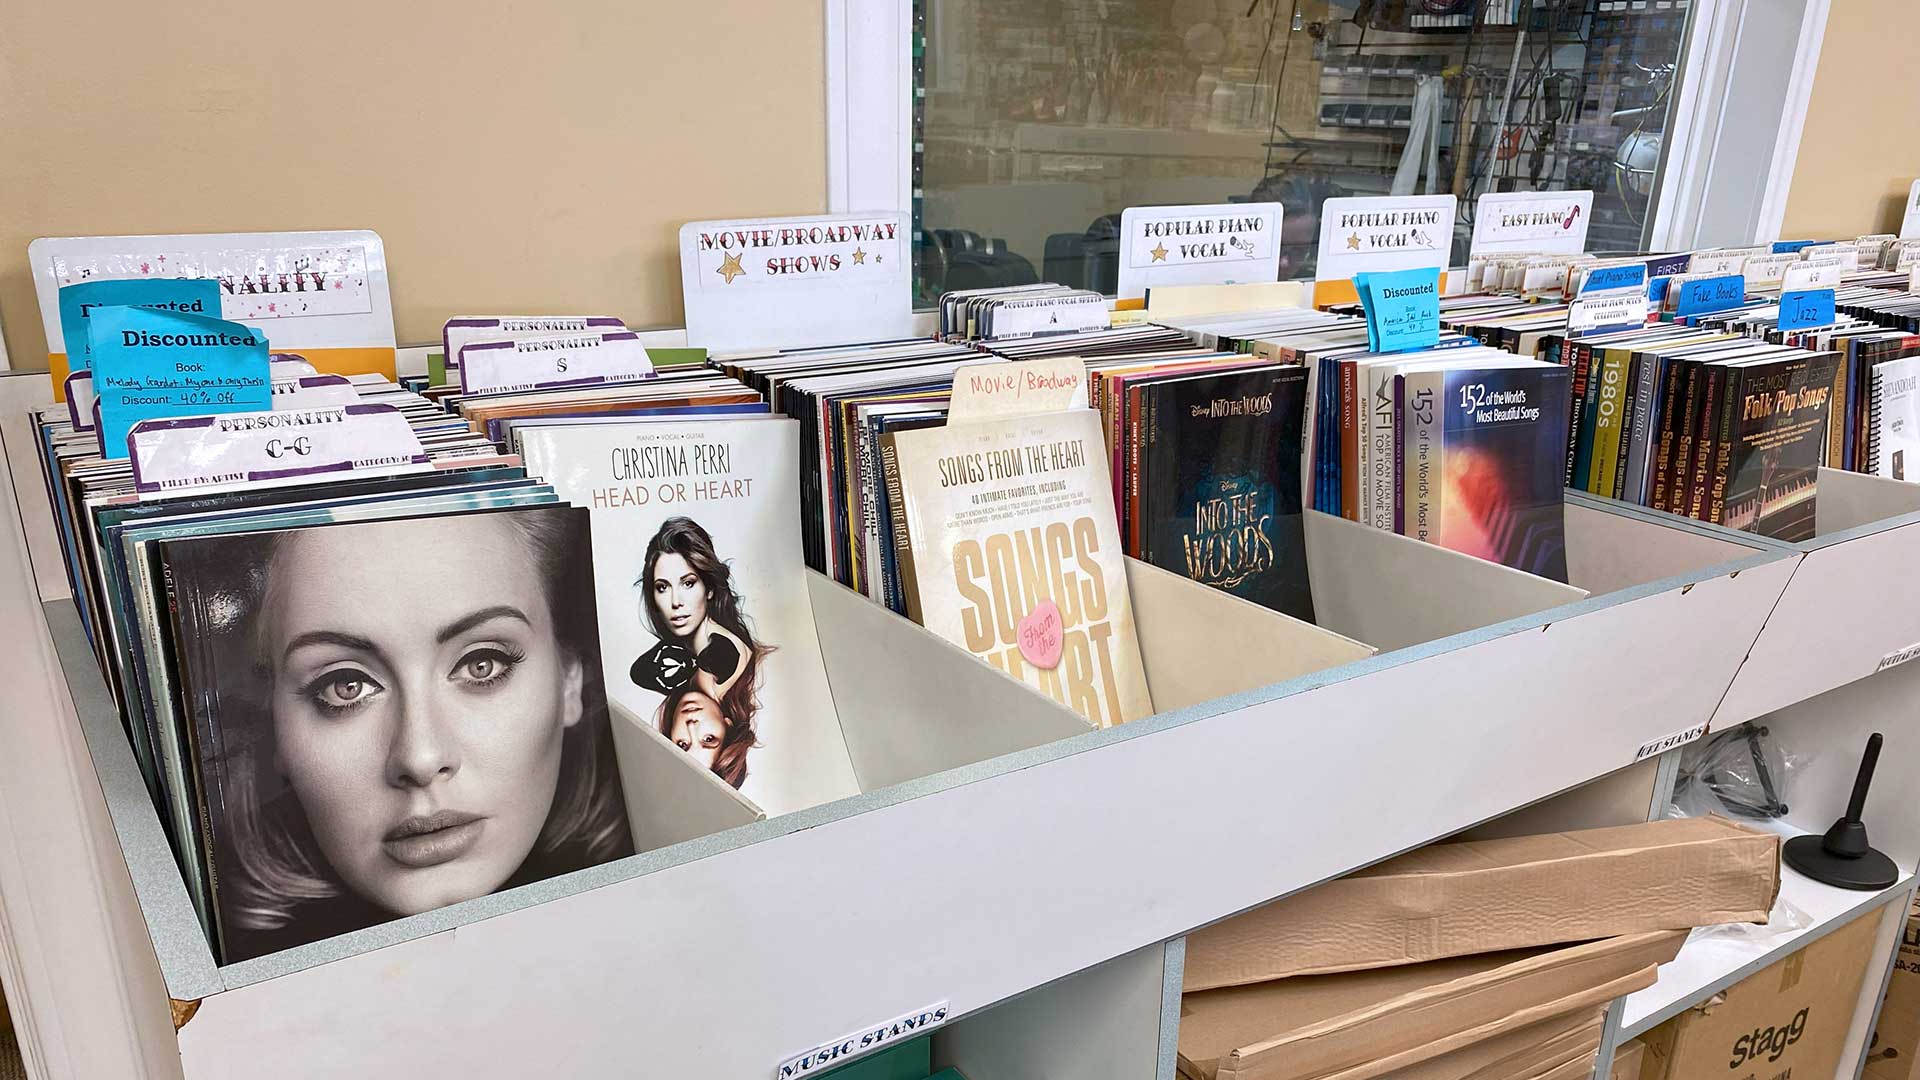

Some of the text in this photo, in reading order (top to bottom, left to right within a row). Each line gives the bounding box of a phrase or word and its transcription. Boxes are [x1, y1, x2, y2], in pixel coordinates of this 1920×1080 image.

[1143, 216, 1264, 238] POPULAR PIANO
[1341, 211, 1440, 228] POPULAR PIANO
[1502, 211, 1566, 228] EASY PIANO
[700, 223, 897, 250] MOVIE/BROADWAY
[1369, 233, 1409, 248] VOCAL
[1180, 243, 1228, 259] VOCAL
[766, 254, 842, 275] SHOWS
[1656, 262, 1683, 276] FIRST
[1382, 282, 1434, 299] Discounted
[1715, 282, 1738, 300] Books
[1049, 311, 1058, 324] A
[1791, 296, 1818, 323] Jazz
[122, 330, 257, 347] Discounted
[503, 321, 586, 332] PERSONALITY
[516, 337, 601, 353] PERSONALITY
[1570, 347, 1579, 366] TOP
[176, 363, 206, 373] Book:
[556, 357, 568, 373] S
[106, 377, 143, 391] Melody
[1344, 367, 1354, 403] america's
[1669, 378, 1677, 394] MOST
[1687, 381, 1695, 398] MOST
[1747, 366, 1834, 393] THE MOST REQUESTED
[122, 395, 172, 406] Discount:
[217, 392, 235, 403] Off
[1190, 393, 1272, 418] Disney INTO THE WOODS
[1458, 383, 1526, 414] 152 of the World's
[1599, 360, 1619, 428] 1980s
[1634, 361, 1652, 441] rest in peace
[1726, 386, 1734, 403] MOST
[1743, 386, 1829, 421] Folk/Pop Songs
[219, 410, 345, 432] PERSONALITY
[1375, 392, 1392, 430] AFI
[1476, 406, 1540, 423] Most Beautiful Songs
[1665, 395, 1675, 430] REQUESTED
[1683, 399, 1693, 435] REQUESTED
[1702, 402, 1712, 439] REQUESTED
[1720, 404, 1731, 441] REQUESTED
[660, 432, 680, 441] VOCAL
[1569, 398, 1581, 450] BROADWAY
[1833, 395, 1843, 457] CLASSICAL TOUCH
[265, 436, 312, 459] C-G
[1375, 433, 1384, 455] TOP
[1384, 433, 1392, 478] AMERICAN
[1657, 431, 1673, 470] Songs
[1675, 436, 1691, 475] Songs
[354, 456, 399, 468] CATEGORY:
[611, 443, 731, 481] CHRISTINA PERRI
[860, 445, 868, 488] MORE
[882, 445, 896, 476] SONGS
[938, 440, 1086, 488] SONGS FROM THE HEART
[1375, 458, 1384, 476] 100
[1412, 388, 1433, 528] 152 of the World's Most
[1695, 440, 1711, 483] Movie
[1712, 442, 1731, 499] Folk/Pop
[161, 474, 193, 488] FILED
[210, 472, 244, 484] ARTIST
[1220, 480, 1238, 492] Disney
[1657, 472, 1665, 481] of
[1676, 477, 1683, 486] of
[592, 478, 753, 509] HEAD OR HEART
[865, 451, 878, 542] MORE CHILL
[887, 475, 903, 504] FROM
[972, 480, 1067, 505] 40 INTIMATE FAVORITES, INCLUDING
[1375, 479, 1384, 510] MOVIE
[1655, 484, 1664, 499] the
[1673, 488, 1683, 504] the
[863, 492, 871, 534] CHILL
[892, 503, 906, 522] THE
[1196, 491, 1258, 535] INTO THE
[894, 522, 910, 551] HEART
[1183, 514, 1274, 588] WOODS
[162, 562, 177, 614] ADELE 25
[956, 516, 1108, 653] SONGS
[1038, 632, 1057, 657] the
[1663, 726, 1703, 750] STANDS
[780, 1007, 946, 1080] MUSIC STANDS
